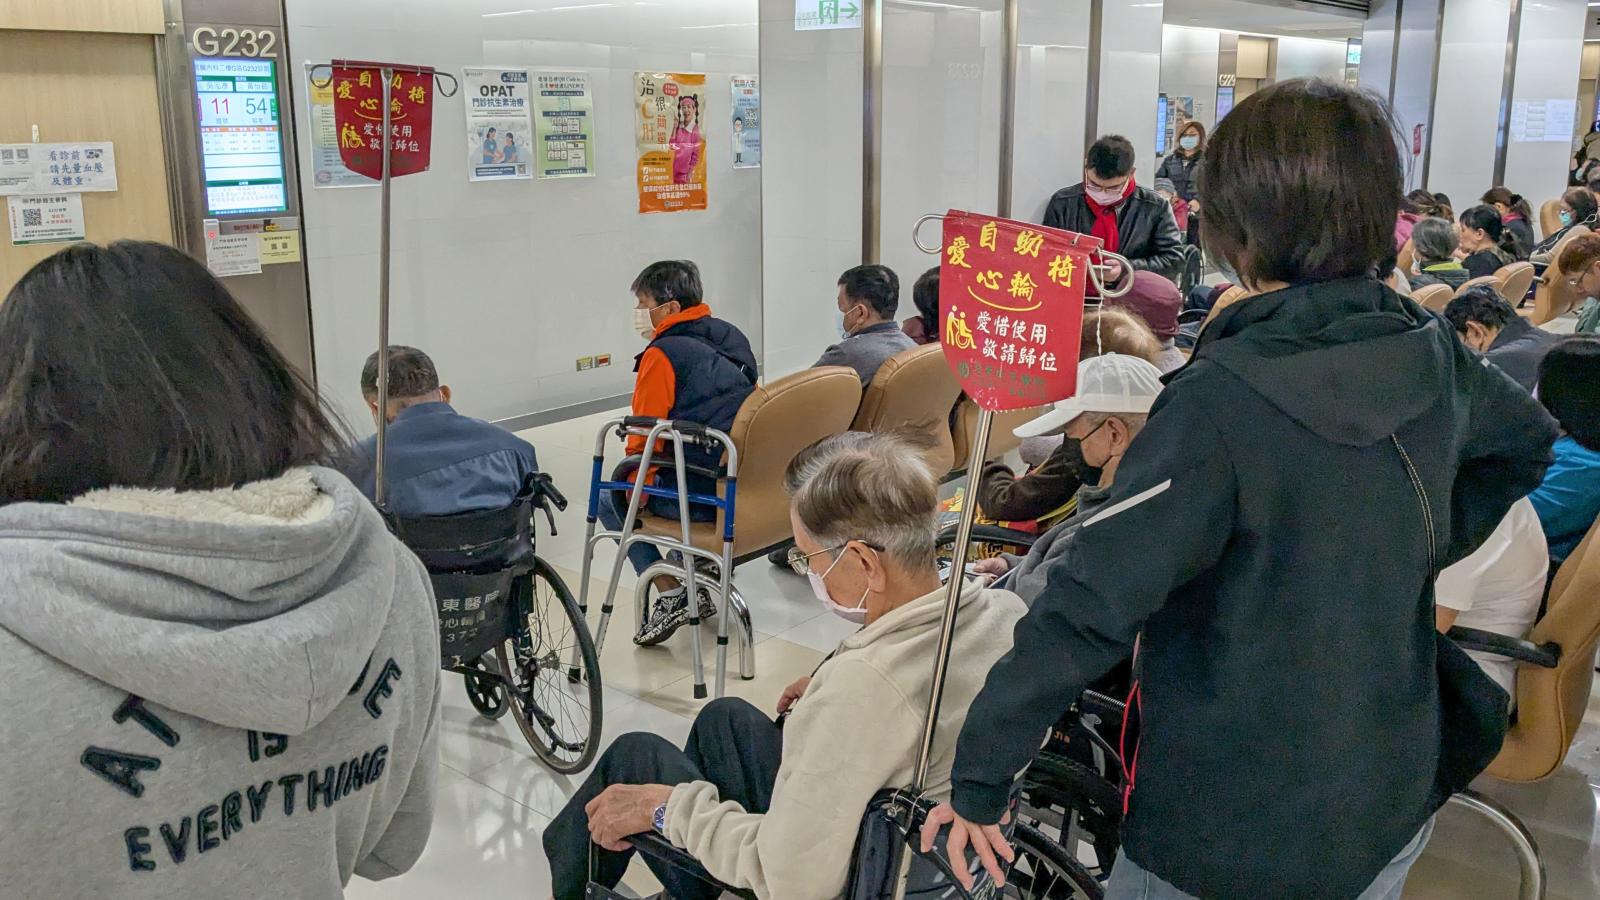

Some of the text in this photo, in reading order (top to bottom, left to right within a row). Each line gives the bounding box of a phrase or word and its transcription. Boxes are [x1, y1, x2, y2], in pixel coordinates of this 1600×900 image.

[192, 26, 278, 58] G232
[479, 84, 515, 97] OPAT
[211, 97, 229, 115] 11
[245, 97, 267, 115] 54
[472, 98, 524, 107] 門診抗生素治療
[369, 139, 420, 152] 敬歸位
[48, 150, 81, 161] 看診前
[50, 162, 104, 174] 請先量血壓
[979, 221, 1044, 258] 自助
[977, 311, 1047, 345] 愛惜使用
[983, 338, 1058, 372] 敬請歸位
[248, 730, 288, 763] IS
[123, 744, 389, 872] EVERYTHING
